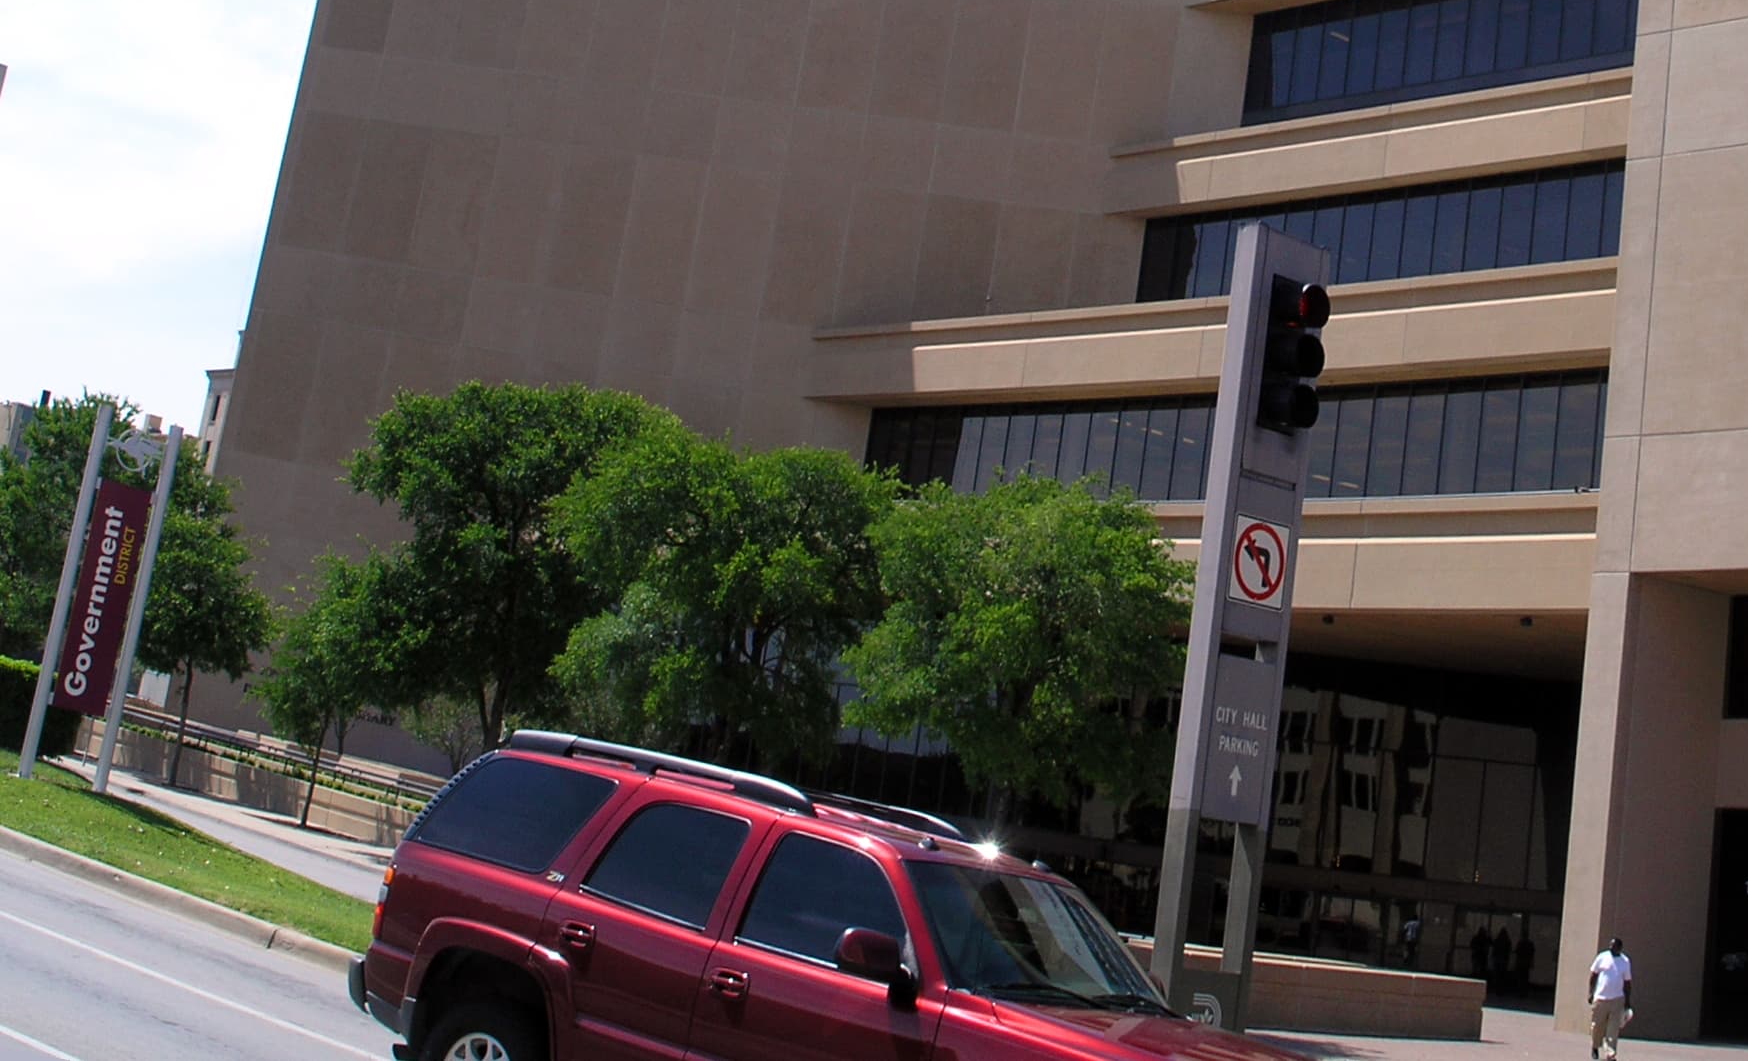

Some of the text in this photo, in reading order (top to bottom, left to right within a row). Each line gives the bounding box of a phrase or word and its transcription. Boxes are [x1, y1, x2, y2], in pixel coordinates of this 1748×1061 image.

[114, 526, 136, 585] DISTRICT
[64, 505, 125, 697] Government
[1215, 706, 1267, 731] CITY HALL
[1218, 735, 1259, 758] PARKING
